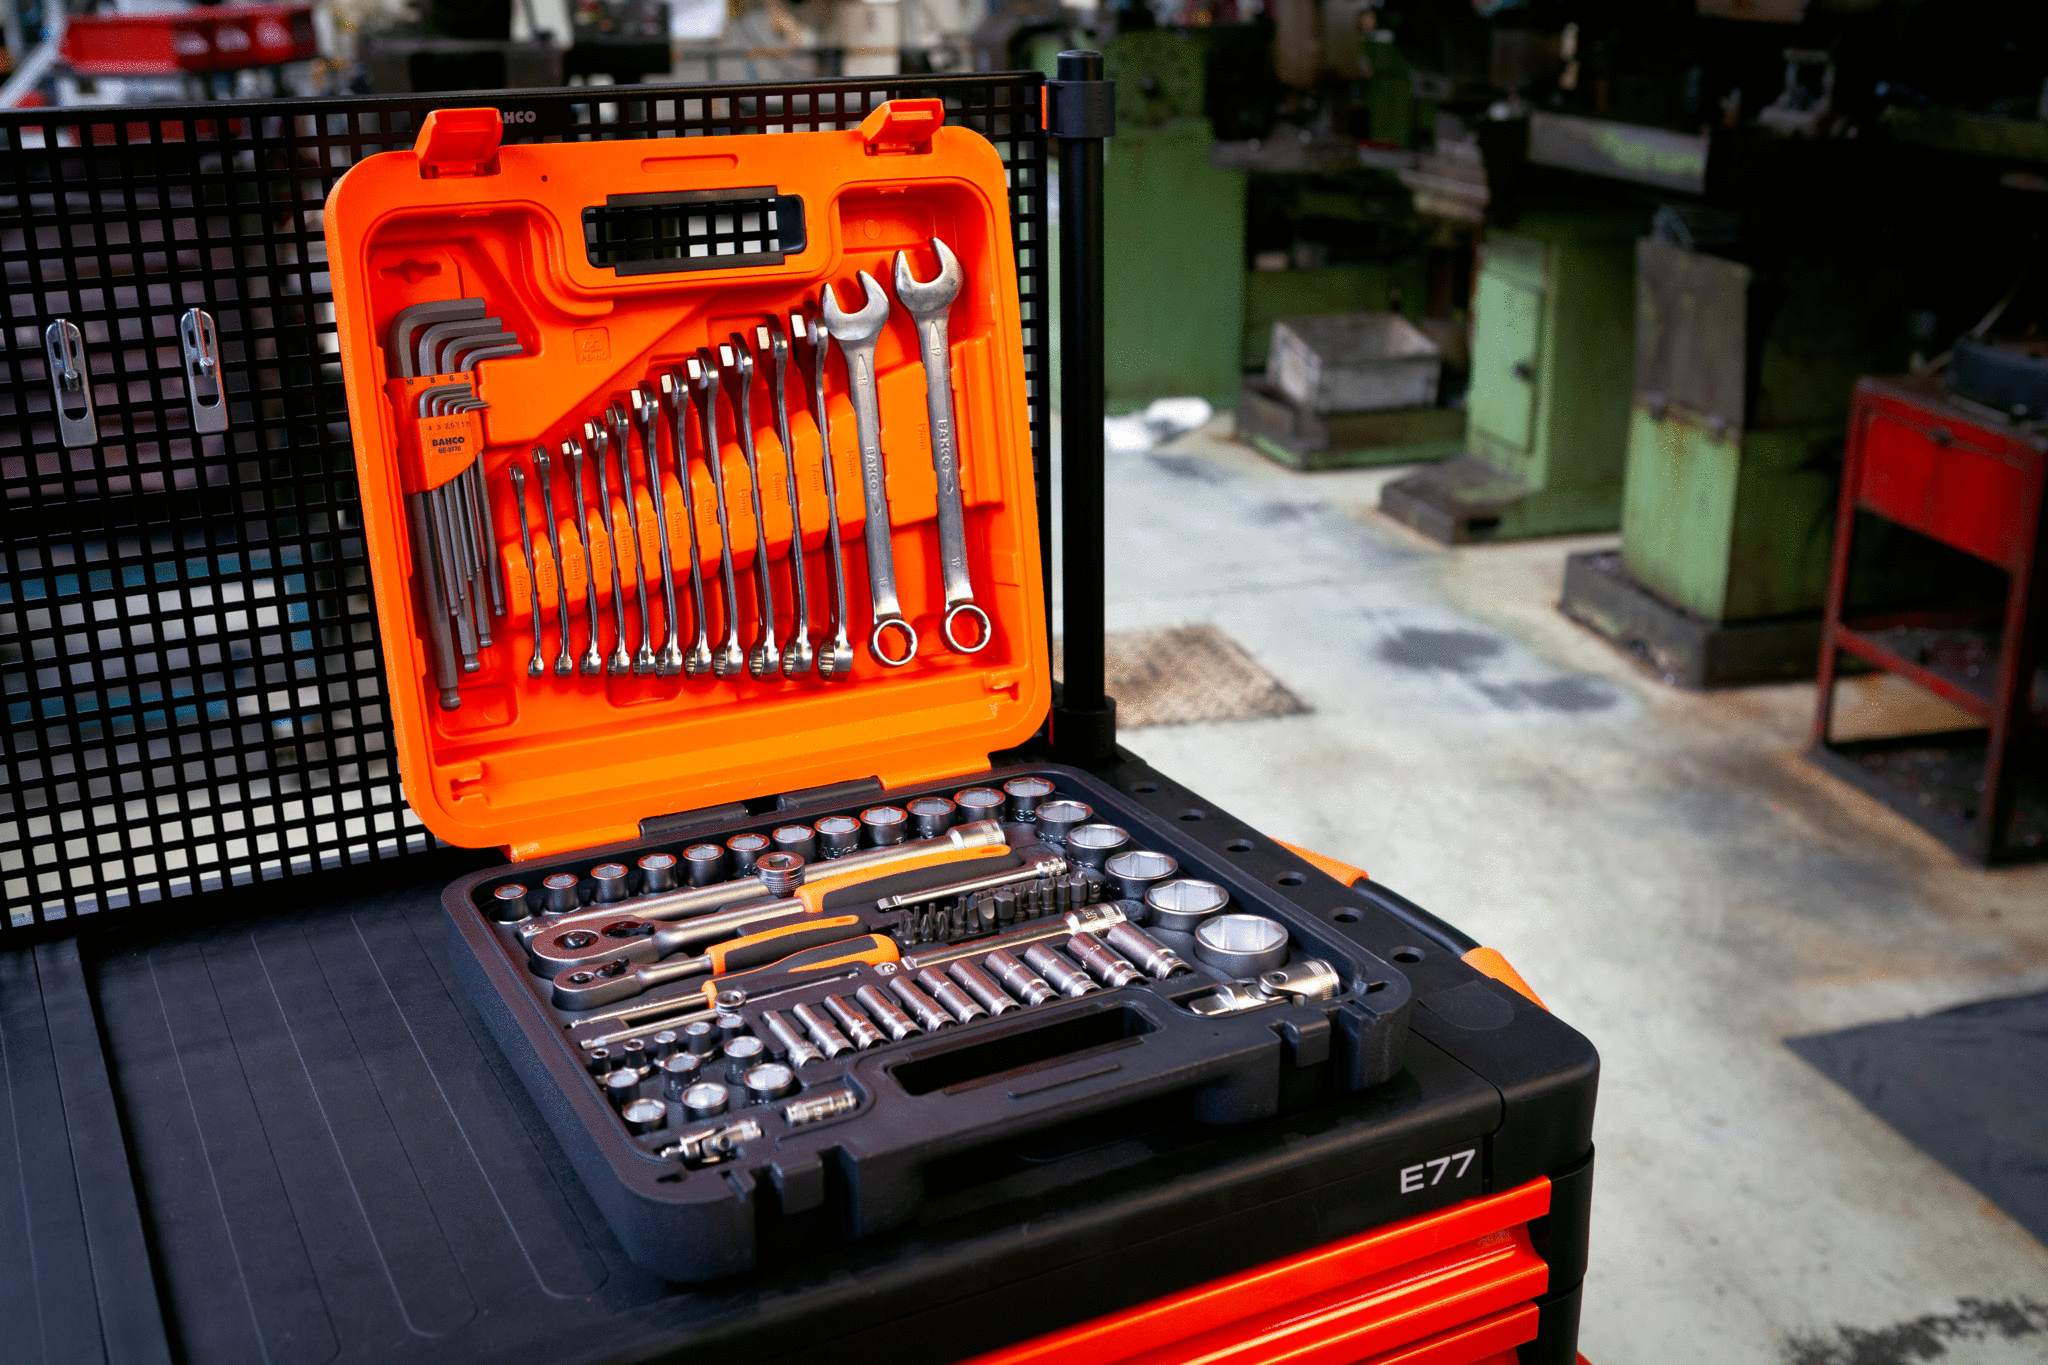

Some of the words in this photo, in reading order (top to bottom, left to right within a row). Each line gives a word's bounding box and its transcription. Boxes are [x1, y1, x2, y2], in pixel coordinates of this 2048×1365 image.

[502, 111, 537, 124] HCO
[432, 436, 465, 447] BAHCO
[938, 419, 951, 465] BAHCO
[866, 446, 880, 490] BAHCO
[619, 527, 631, 557] 11mm
[644, 517, 655, 547] 12mm
[570, 554, 580, 580] 9mm
[595, 540, 606, 569] 10mm
[516, 571, 527, 598] 7mm
[542, 562, 552, 588] 8mm
[1400, 1150, 1476, 1195] E77
